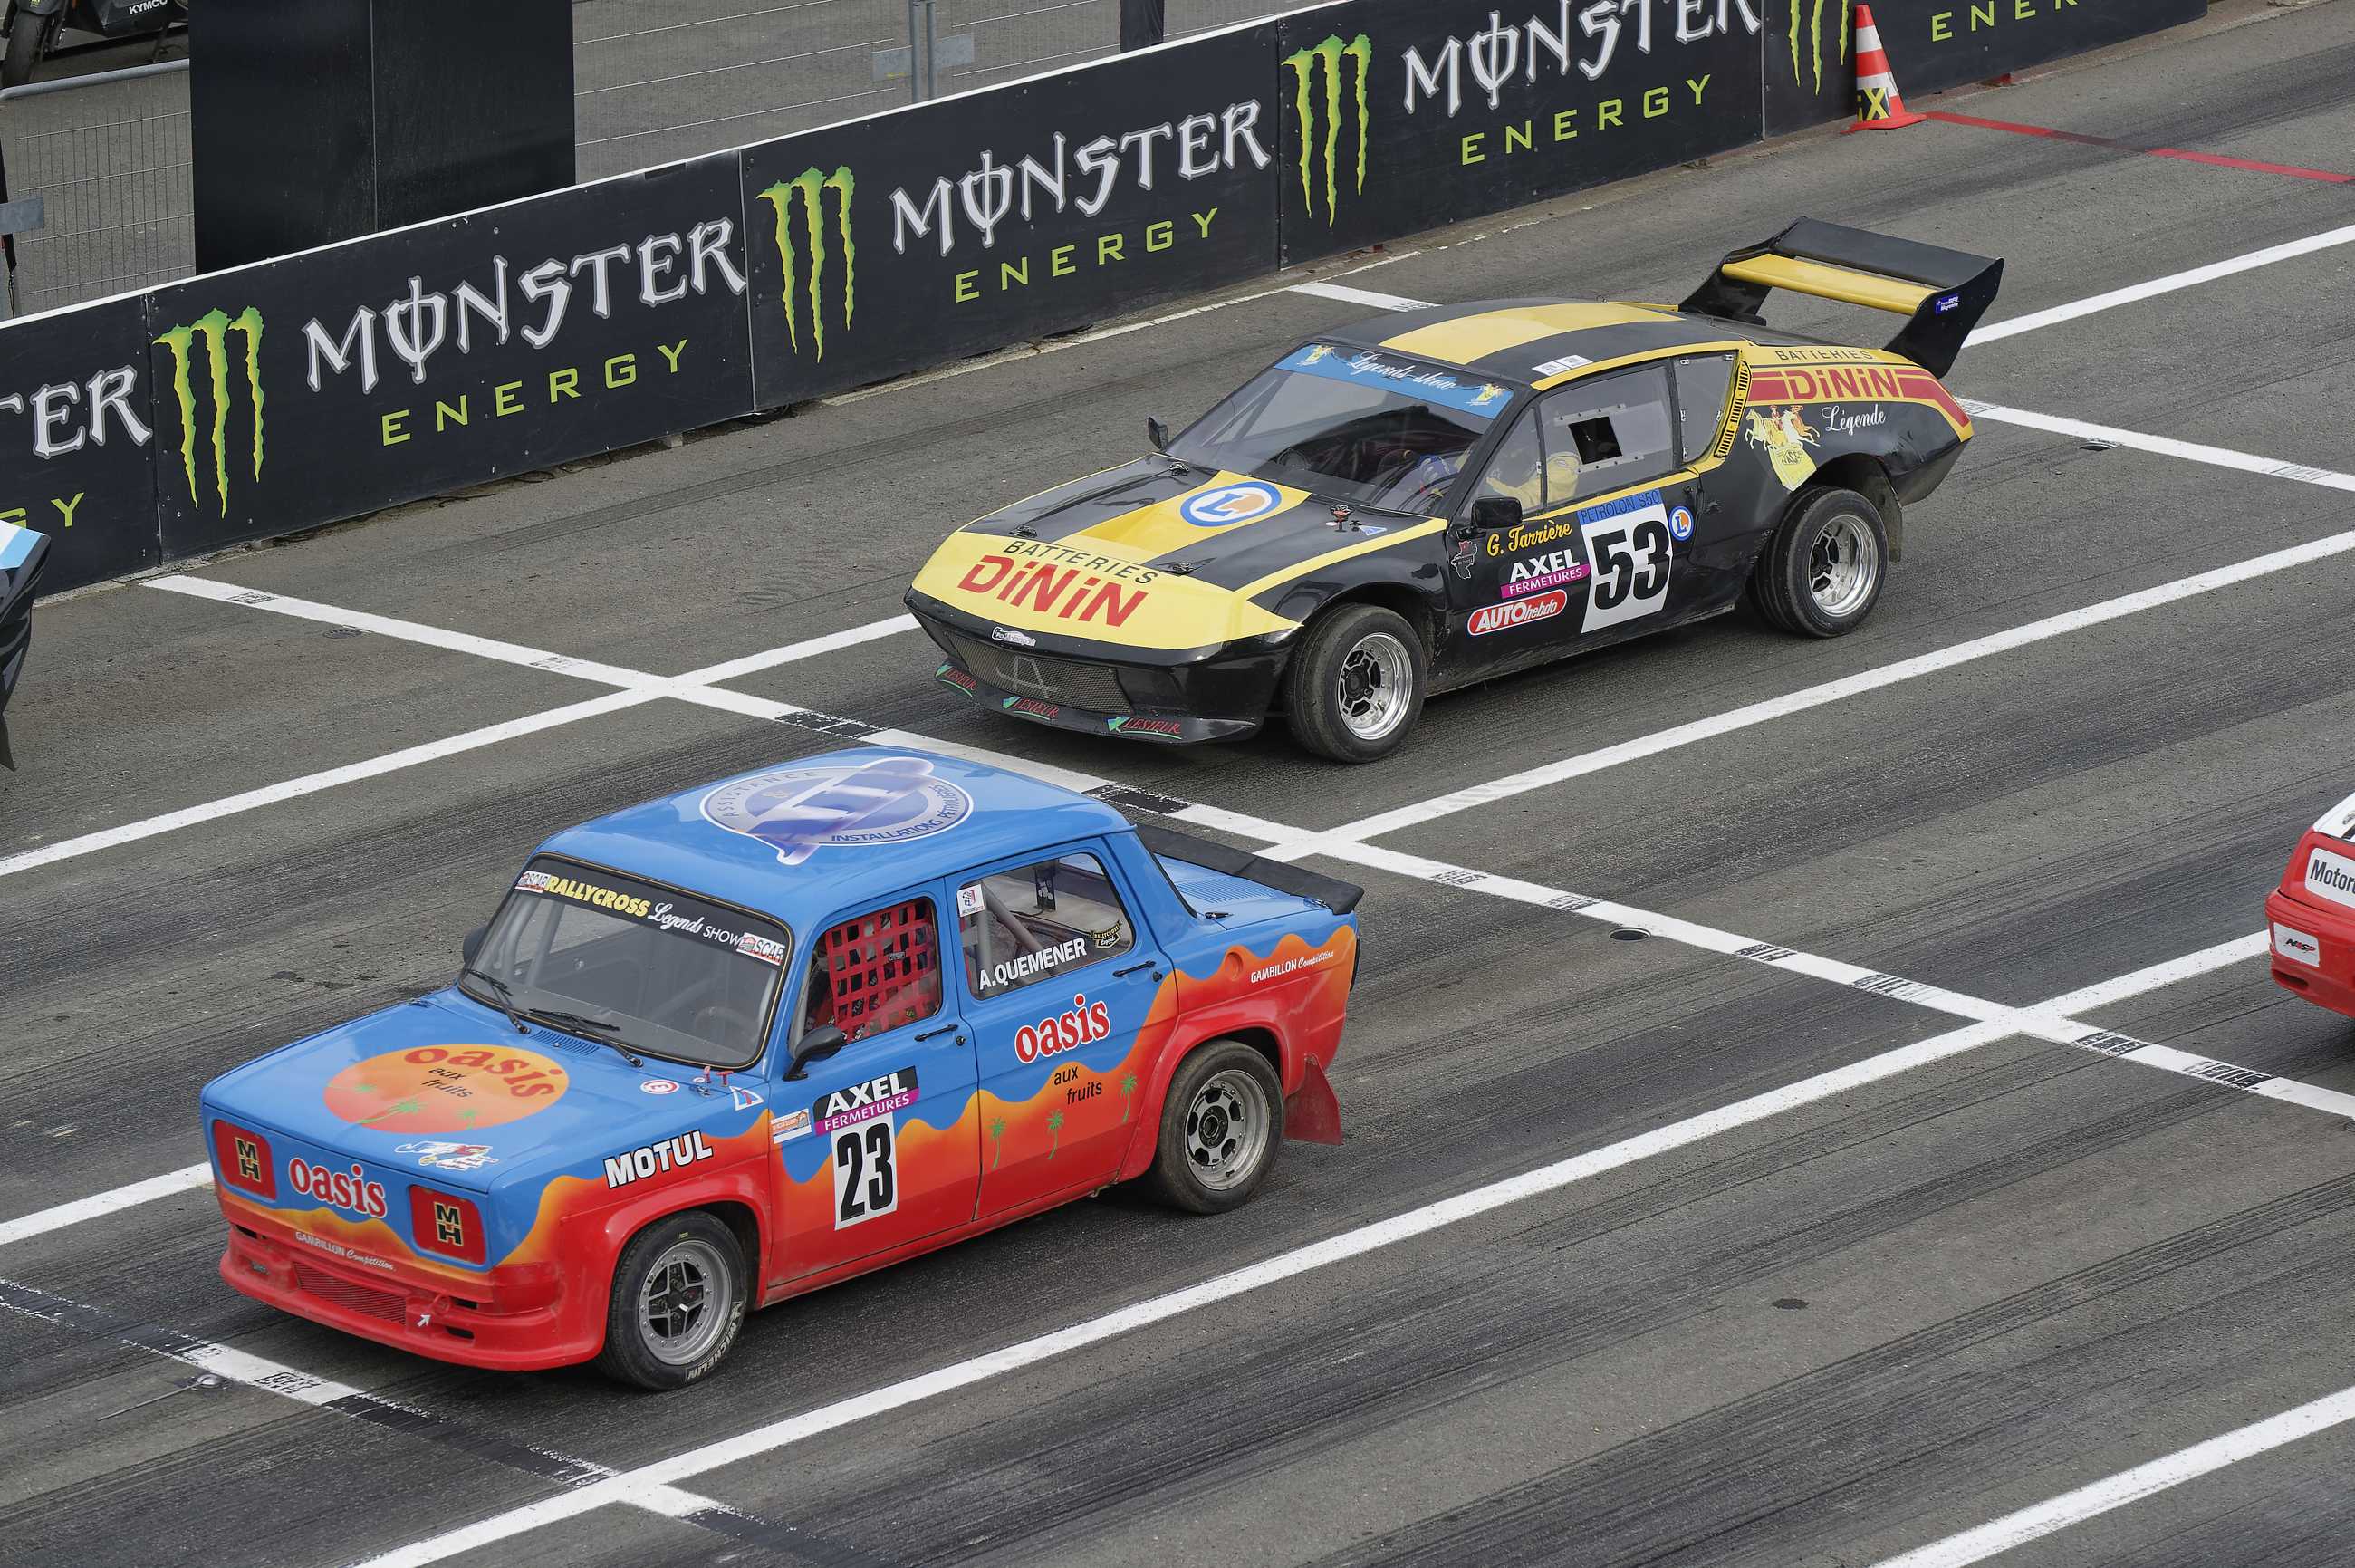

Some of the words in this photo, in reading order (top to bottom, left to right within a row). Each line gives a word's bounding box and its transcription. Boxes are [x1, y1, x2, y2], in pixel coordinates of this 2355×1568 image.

[129, 0, 168, 15] KYMCO
[1461, 74, 1711, 166] ENERGY
[889, 99, 1271, 257] MONSTER
[955, 207, 1218, 303] ENERGY
[302, 217, 747, 393] MONSTER
[1775, 348, 1876, 361] BATTERIES
[381, 339, 687, 446] ENERGY
[1004, 541, 1159, 584] BATTERIES
[1486, 533, 1504, 557] G.
[1509, 549, 1581, 583] AXEL
[1509, 568, 1583, 595] FERMETURES
[1591, 520, 1671, 610] 53
[945, 667, 977, 690] LESIEUR
[1014, 698, 1059, 717] LESIEUR
[1123, 717, 1182, 734] LESIEUR
[831, 819, 944, 842] INSTALLATIONS
[2310, 859, 2355, 896] Motor
[544, 875, 651, 918] RALLYCROSS
[647, 902, 704, 931] Legends
[703, 925, 743, 947] SHOW
[1251, 960, 1297, 984] GAMBILLON
[1014, 994, 1110, 1064] oasis
[404, 1047, 563, 1099] oasis
[421, 1079, 473, 1099] fruits
[428, 1065, 466, 1082] aux
[1053, 1066, 1079, 1085] aux
[825, 1073, 907, 1118] AXEL
[1066, 1082, 1102, 1104] fruits
[824, 1094, 910, 1131] FERMETURES
[603, 1130, 713, 1189] MOTUL
[836, 1122, 895, 1223] 23
[288, 1158, 388, 1218] oasis
[295, 1231, 345, 1256] GAMBILLON
